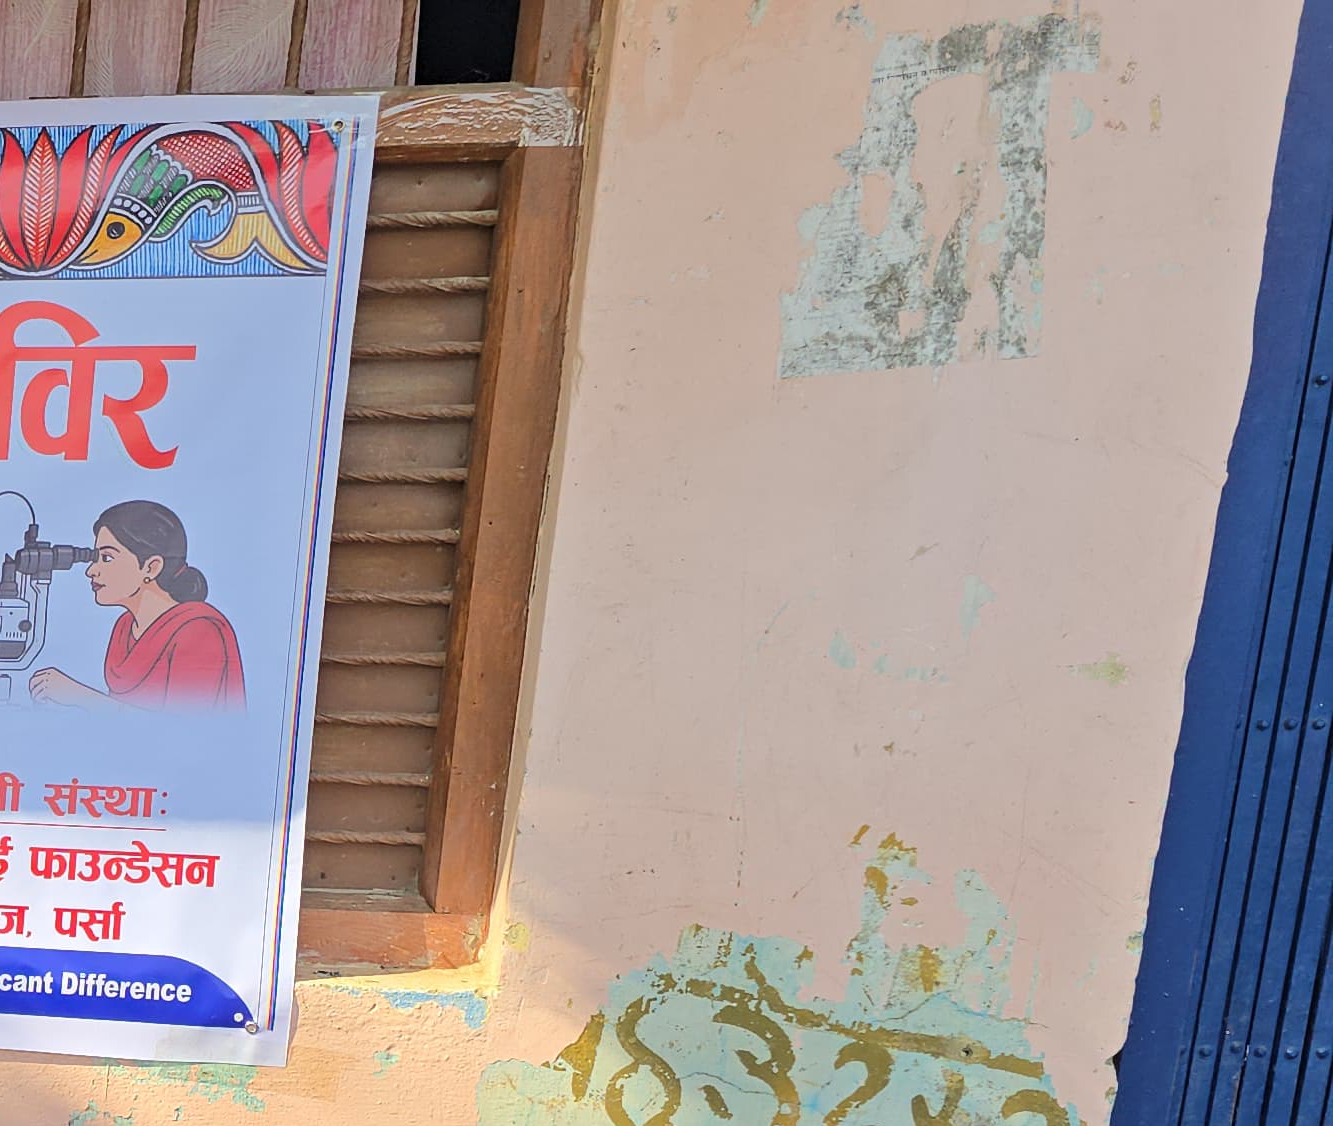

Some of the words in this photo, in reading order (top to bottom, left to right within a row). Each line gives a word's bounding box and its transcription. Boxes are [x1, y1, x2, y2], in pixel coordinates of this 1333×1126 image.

[29, 841, 220, 888] फाउन्डेसन
[54, 901, 126, 941] पर्सा
[61, 972, 192, 1002] Difference
